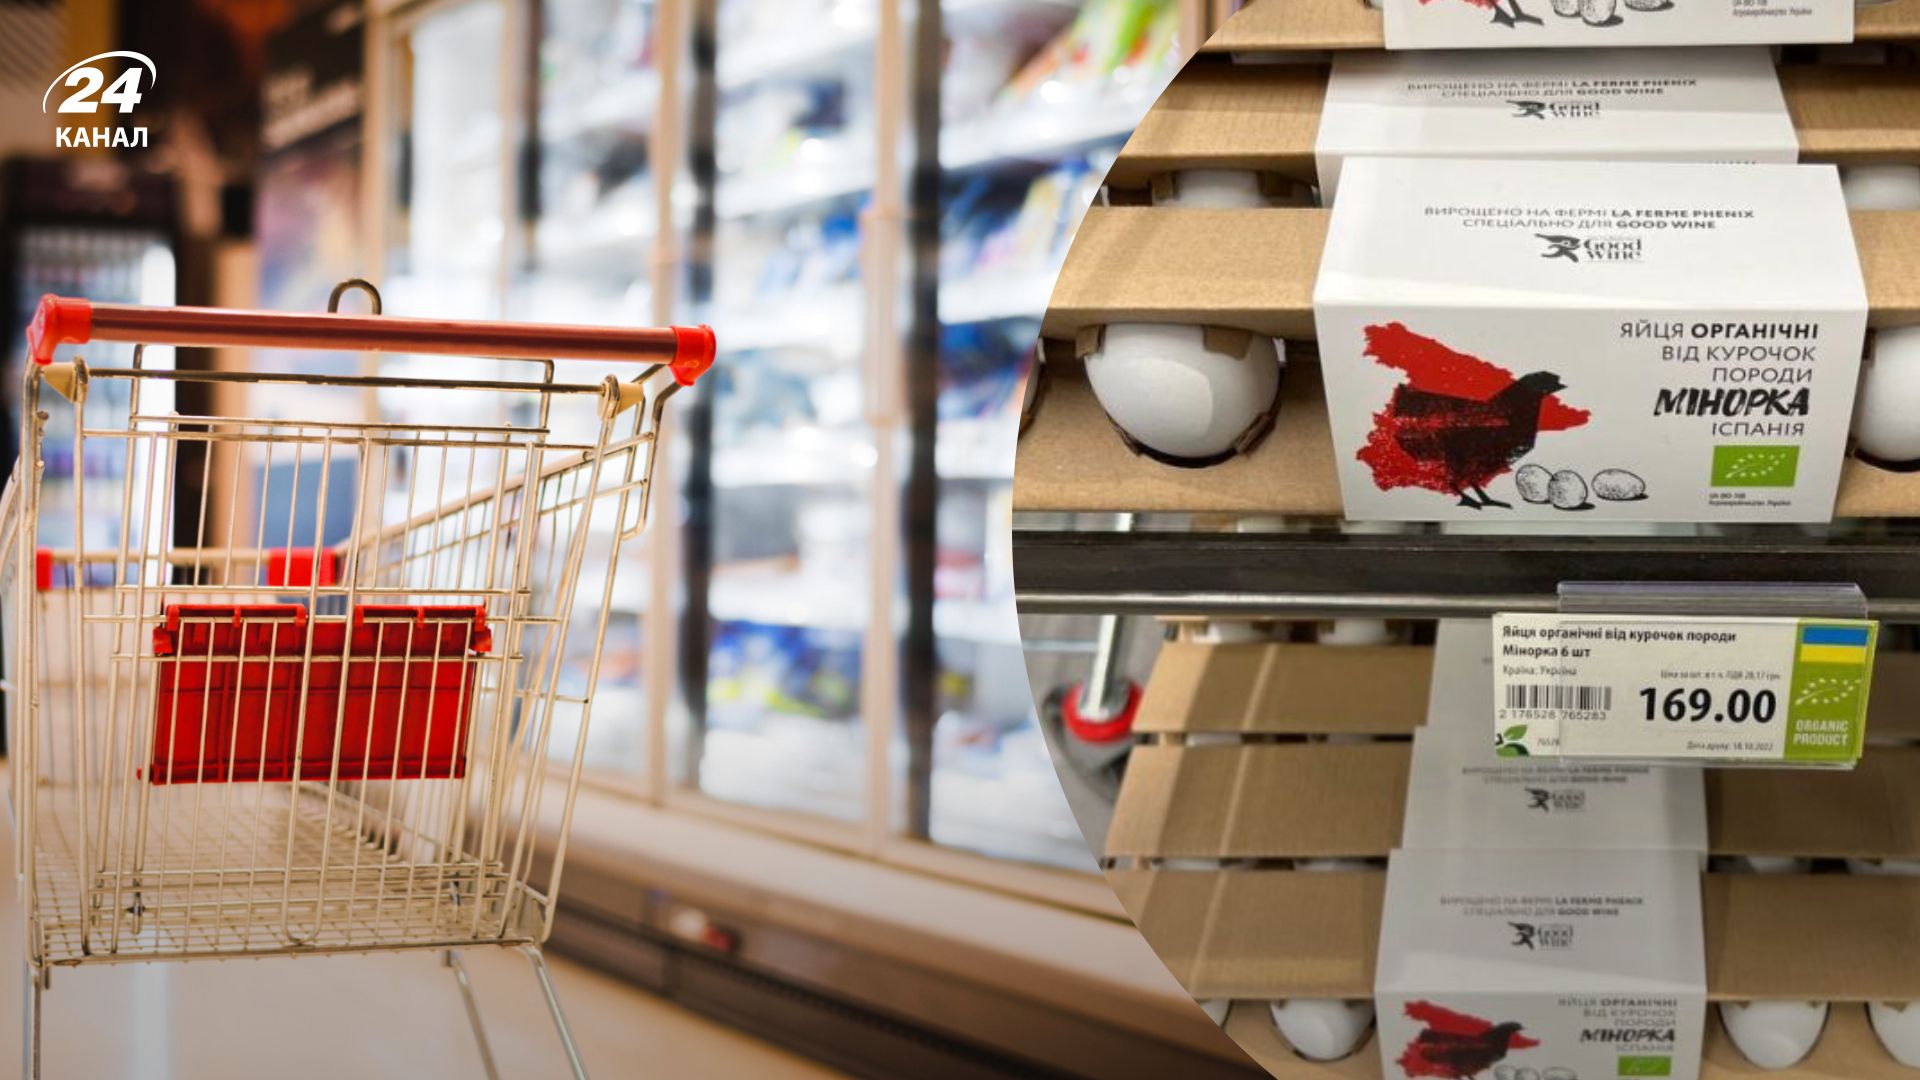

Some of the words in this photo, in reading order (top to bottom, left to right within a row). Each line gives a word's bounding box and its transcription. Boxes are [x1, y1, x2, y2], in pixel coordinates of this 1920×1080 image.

[1571, 80, 1591, 88] LA
[1593, 80, 1639, 88] FERME
[1576, 88, 1621, 96] GOOD
[1624, 87, 1665, 96] WINE
[1424, 206, 1523, 218] ВИРОЩЕНО
[1527, 207, 1551, 217] НА
[1554, 208, 1607, 218] ФЕРМІ
[1611, 208, 1635, 218] LA
[1636, 208, 1690, 219] FERME
[1693, 209, 1755, 219] PHENIX
[1462, 218, 1574, 229] СПЕЦІАЛЬНО
[1578, 219, 1613, 230] ДЛЯ
[1616, 219, 1667, 230] GOOD
[1671, 219, 1717, 230] WINE
[1620, 319, 1684, 341] ЯЙЦЯ
[1691, 322, 1819, 339] ОРГАНІЧНІ
[1662, 346, 1700, 362] ВІД
[1707, 346, 1817, 361] КУРОЧОК
[1712, 367, 1813, 384] ПОРОДИ
[1653, 387, 1811, 417] МІНОРКА
[1712, 422, 1806, 436] ІСПАНІЯ
[1502, 625, 1537, 639] Яйця
[1539, 628, 1603, 642] органічні
[1605, 628, 1627, 642] від
[1629, 631, 1684, 643] курочок
[1687, 631, 1737, 644] породи
[1502, 644, 1558, 659] Мінорка
[1560, 646, 1569, 658] 6
[1571, 647, 1592, 658] шт
[1639, 687, 1777, 724] 169.00
[1499, 709, 1507, 720] 2
[1511, 709, 1557, 720] 176528
[1796, 720, 1850, 732] ORGANIC
[1793, 732, 1849, 746] PRODUCT
[1580, 1028, 1676, 1043] МІНОРКА
